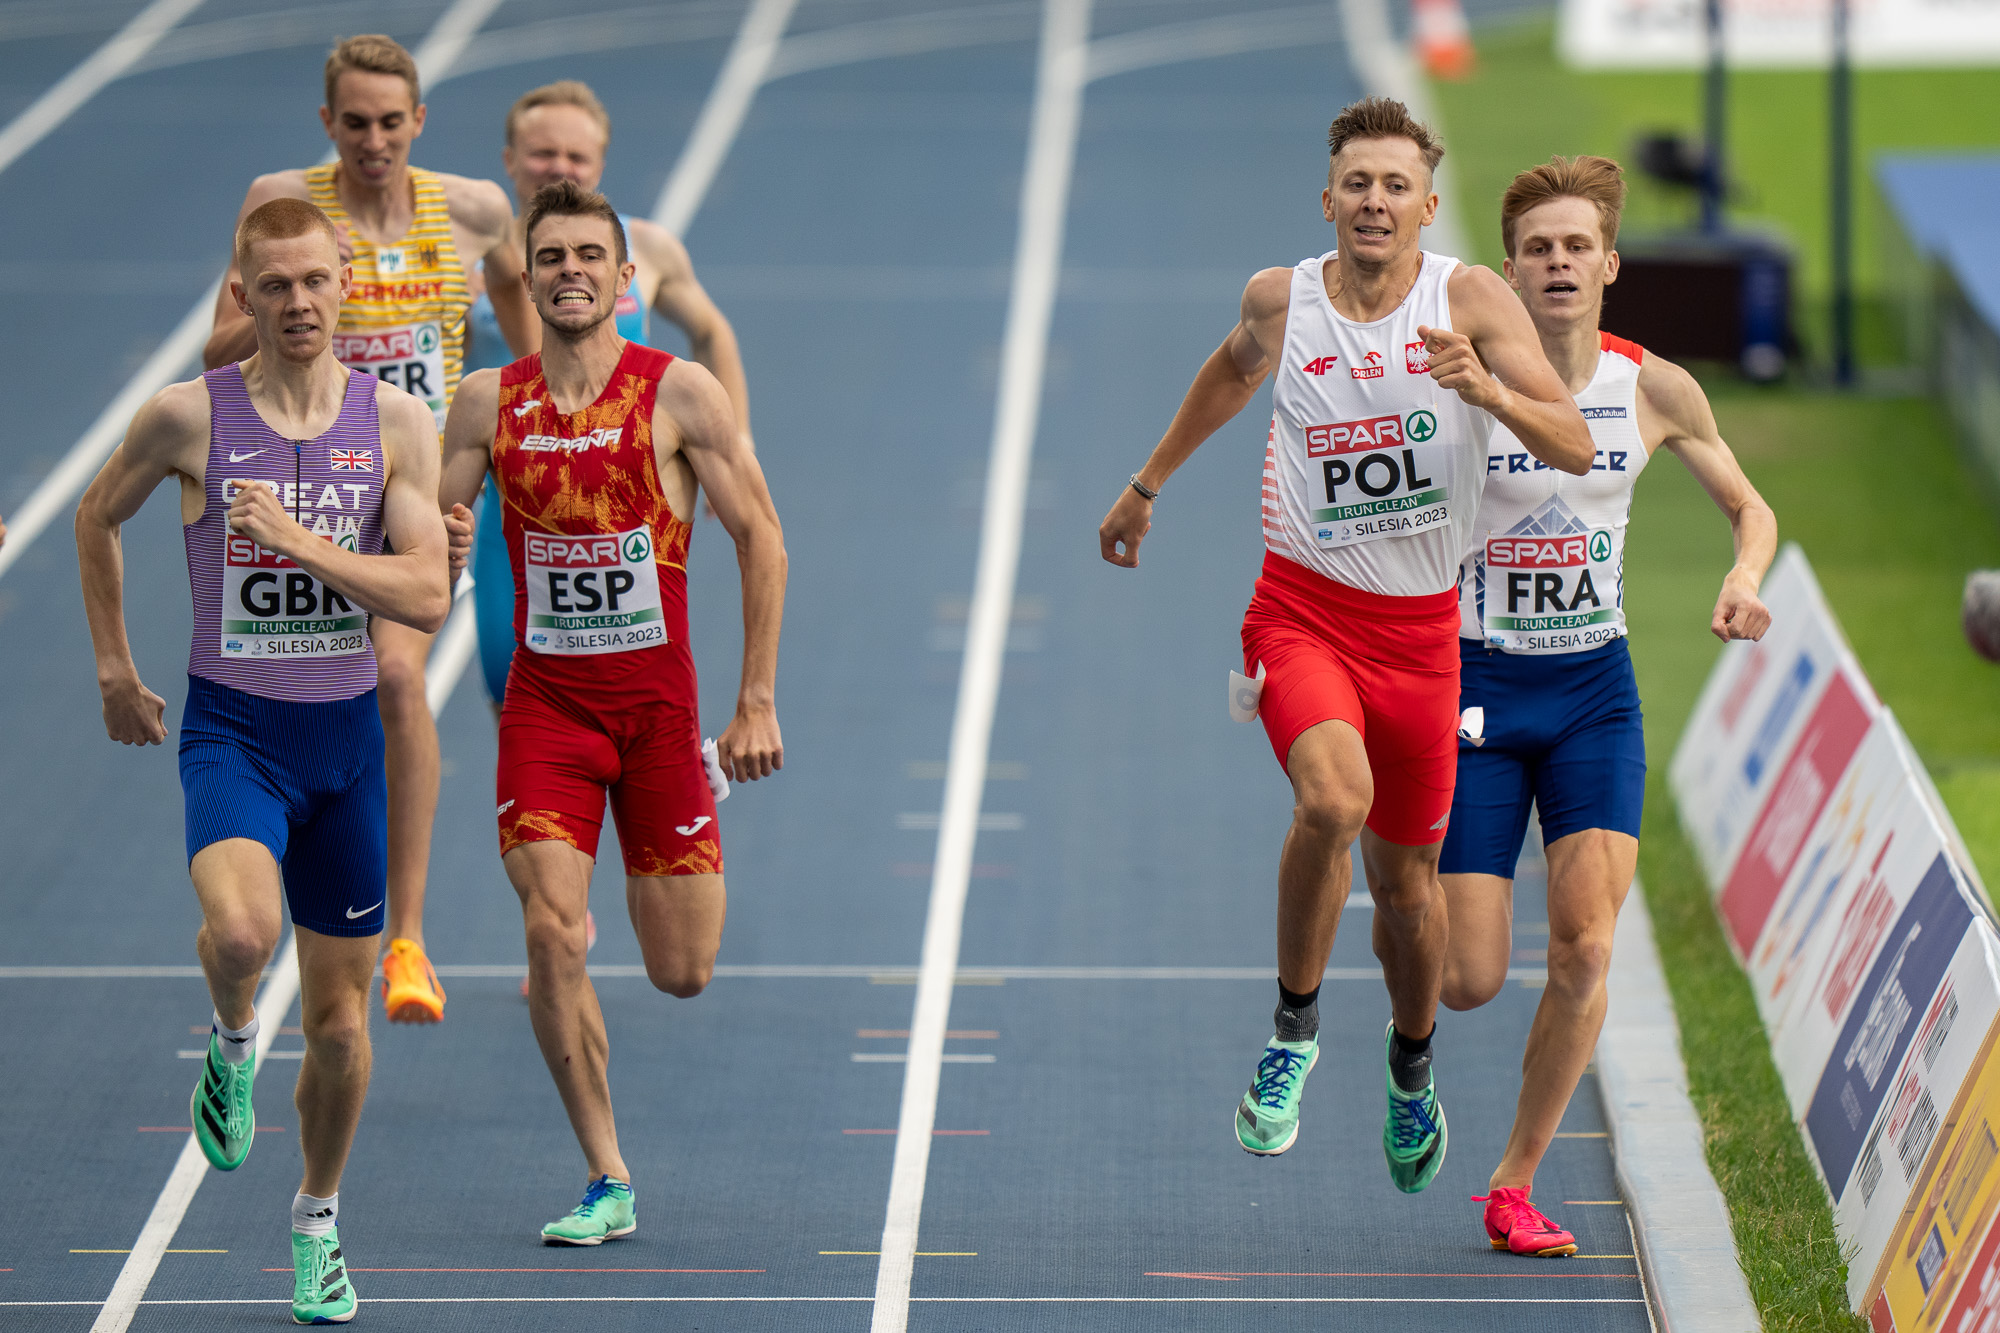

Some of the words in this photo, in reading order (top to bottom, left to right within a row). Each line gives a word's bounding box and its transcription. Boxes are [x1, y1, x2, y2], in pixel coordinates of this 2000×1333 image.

[350, 281, 444, 301] ERMANY
[1303, 356, 1338, 376] 4F
[1352, 367, 1382, 378] ORLEN
[351, 361, 433, 396] ER
[1602, 409, 1626, 418] Mutuel
[519, 427, 623, 454] ESPAÑA
[1309, 421, 1401, 453] SPAR
[1322, 448, 1432, 504] POL
[1344, 504, 1375, 518] RUN
[1355, 517, 1412, 536] SILESIA
[1414, 507, 1448, 527] 2023
[528, 540, 618, 564] SPAR
[1490, 540, 1585, 565] SPAR
[548, 570, 635, 613] ESP
[1507, 568, 1601, 614] FRA
[260, 622, 288, 633] RUN
[559, 616, 585, 629] RUN
[1519, 618, 1549, 629] RUN
[267, 640, 326, 654] SILESIA
[330, 635, 363, 651] 2023
[567, 633, 623, 648] SILESIA
[627, 627, 662, 645] 2023
[1528, 635, 1581, 649] SILESIA
[1584, 628, 1618, 644] 2023
